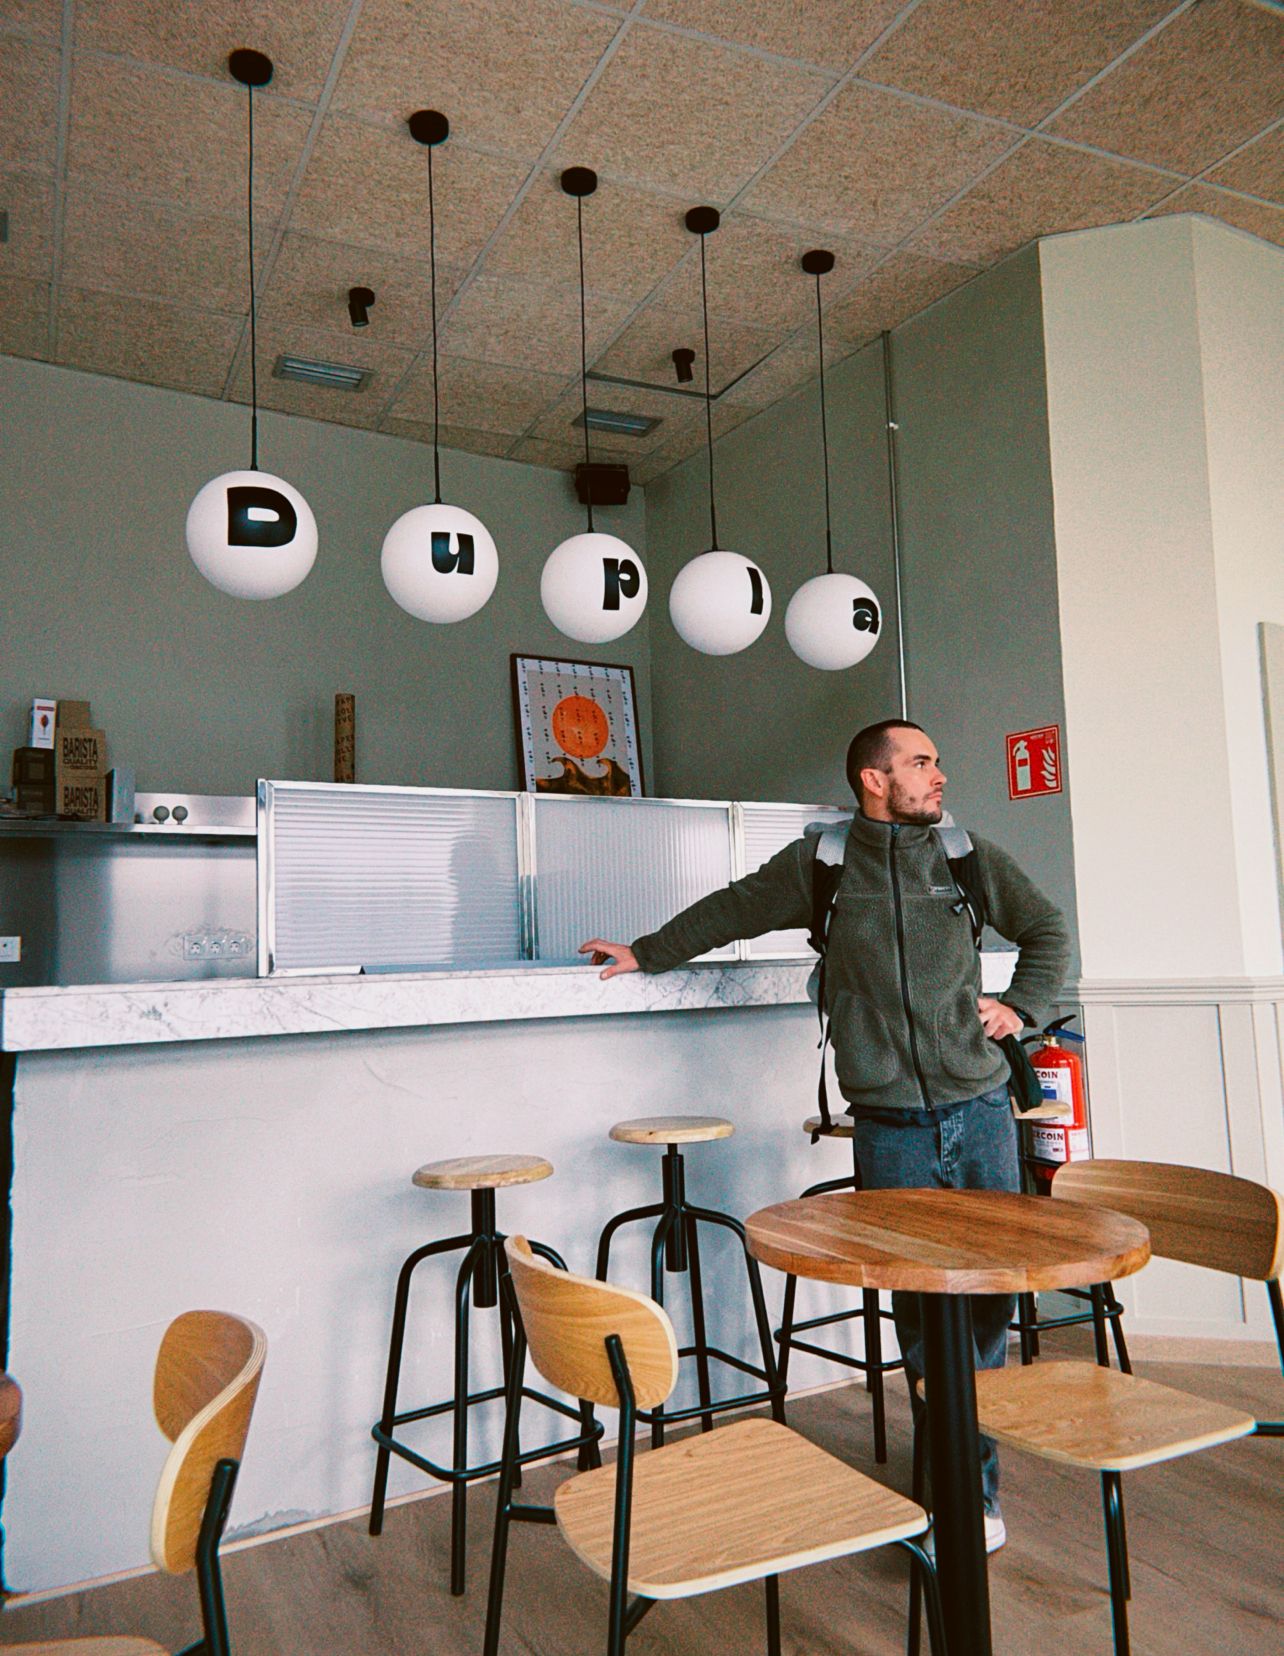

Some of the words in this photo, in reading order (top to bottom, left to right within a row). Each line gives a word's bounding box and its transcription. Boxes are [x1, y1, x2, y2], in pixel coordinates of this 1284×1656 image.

[226, 485, 880, 636] Dupla
[63, 737, 98, 758] BARISTA
[64, 786, 99, 808] BARISTA
[1034, 1070, 1058, 1079] COIN
